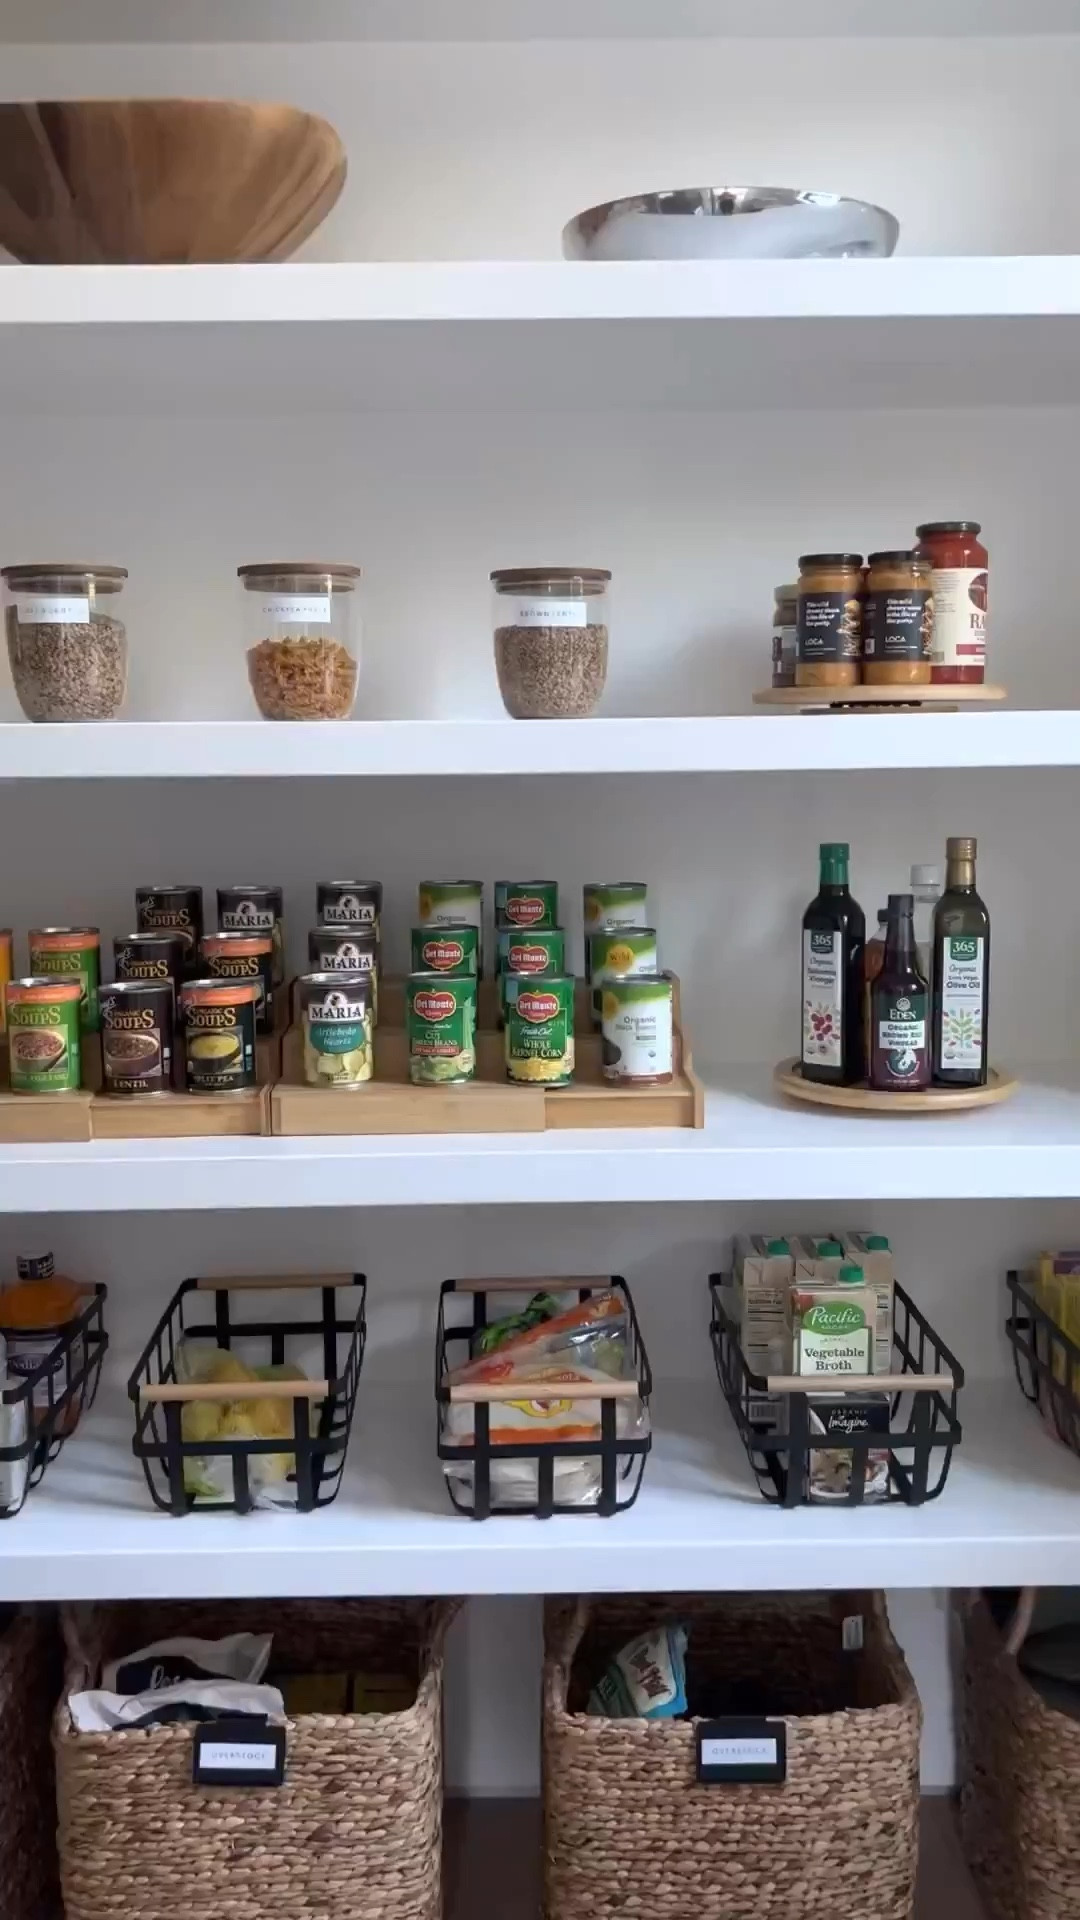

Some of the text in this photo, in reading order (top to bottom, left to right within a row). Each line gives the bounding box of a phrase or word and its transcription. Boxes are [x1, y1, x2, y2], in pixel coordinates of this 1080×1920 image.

[143, 908, 191, 926] SOUPS
[326, 908, 373, 920] MARIA
[224, 915, 271, 926] MARIA
[813, 935, 832, 945] 365
[953, 941, 975, 953] 365
[32, 952, 81, 971] SOUPS
[119, 958, 169, 977] SOUPS
[209, 957, 259, 977] SOUPS
[323, 956, 371, 969] MARIA
[417, 1000, 453, 1009] Del Monte
[520, 1000, 556, 1010] Del Monte
[11, 1006, 61, 1025] SOUPS
[187, 1006, 236, 1026] SOUPS
[311, 1006, 362, 1019] MARIA
[889, 1008, 916, 1020] EDEN
[104, 1009, 155, 1029] SOUPS
[523, 1039, 552, 1049] WHOLE
[541, 1048, 563, 1057] CORN
[113, 1080, 149, 1088] LENTIL
[808, 1306, 861, 1326] Pacific
[805, 1347, 865, 1360] Vegetable
[816, 1360, 852, 1371] Broth
